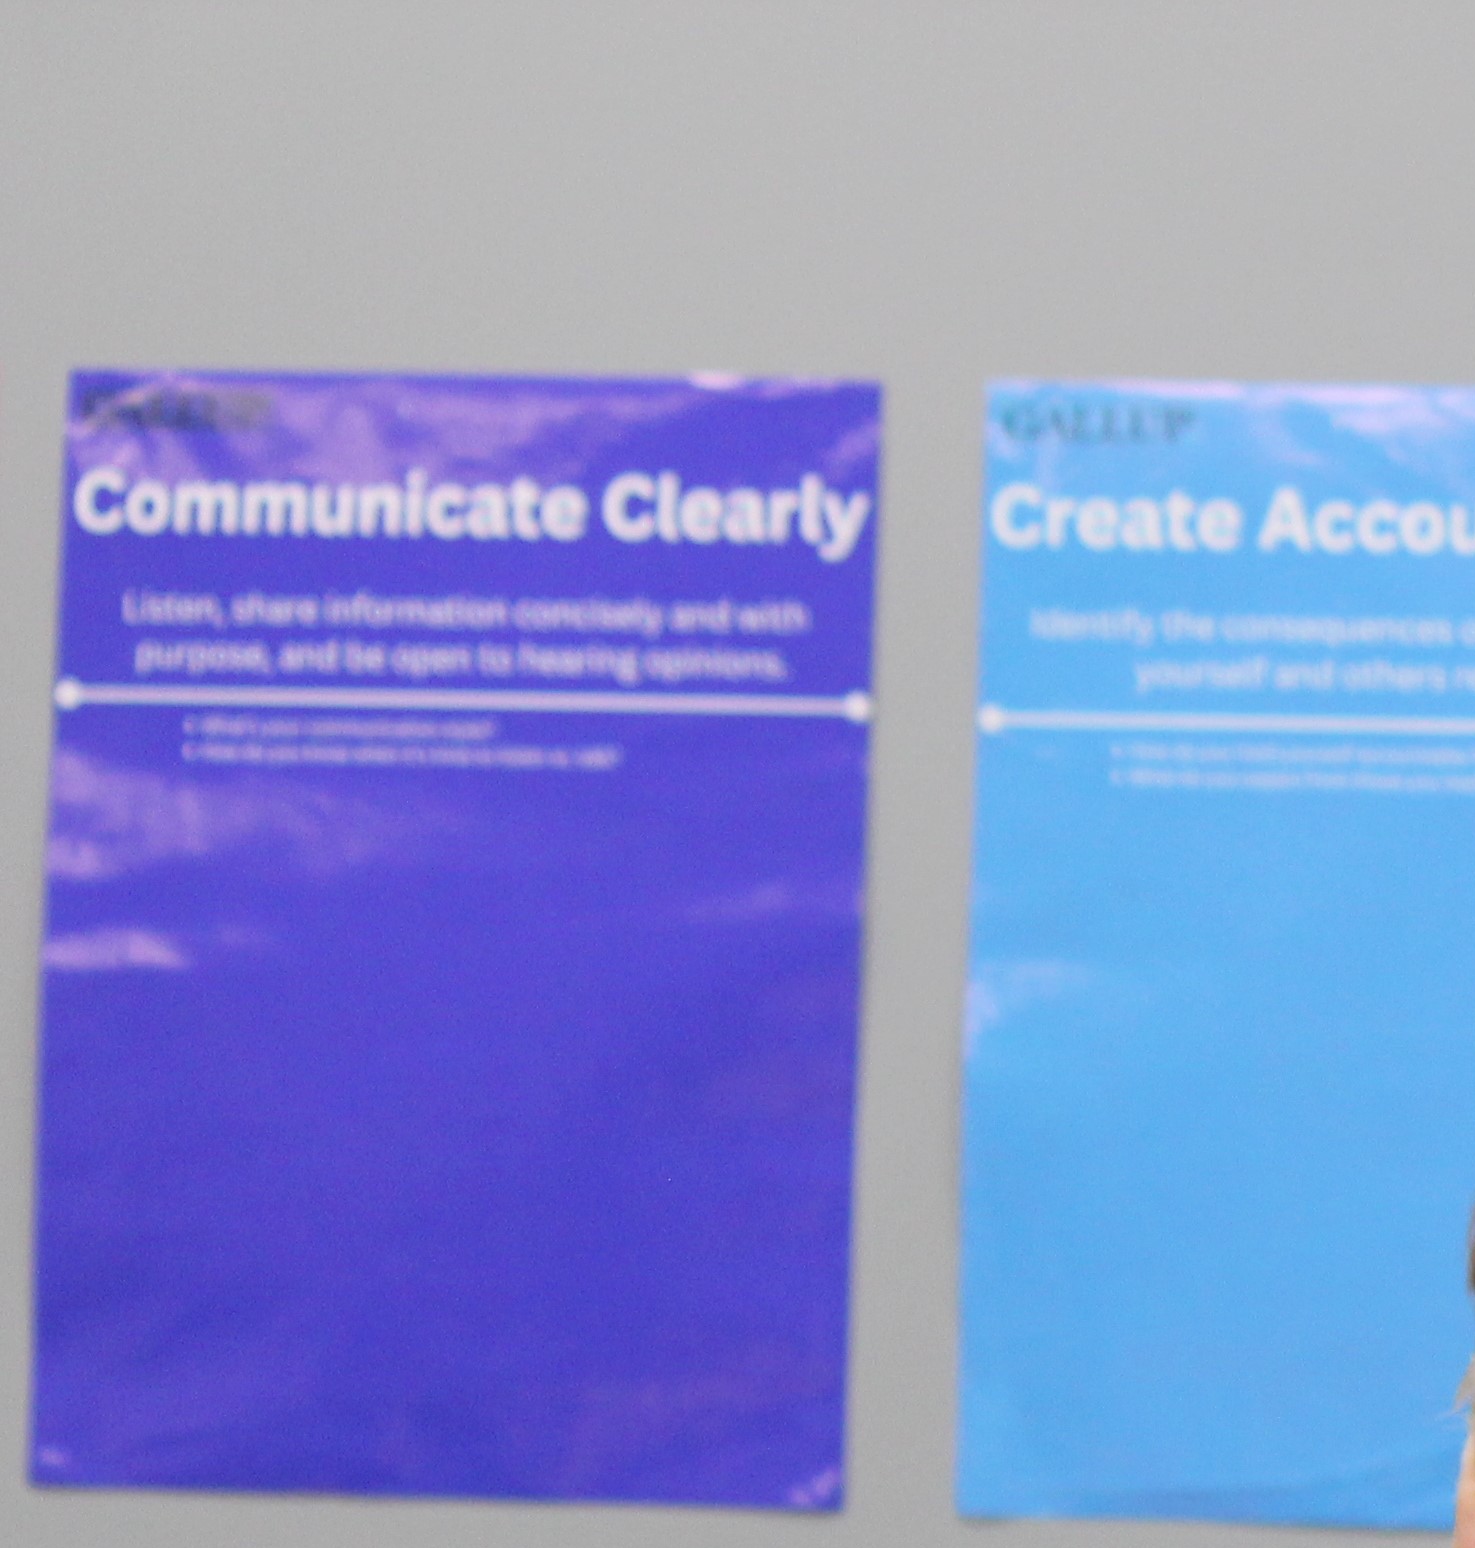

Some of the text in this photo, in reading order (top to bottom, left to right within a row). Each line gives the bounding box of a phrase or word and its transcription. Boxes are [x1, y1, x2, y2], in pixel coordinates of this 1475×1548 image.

[74, 467, 869, 562] Communicate Clearly
[989, 482, 1243, 551] Create
[122, 590, 811, 641] Listen, share information concisely and with
